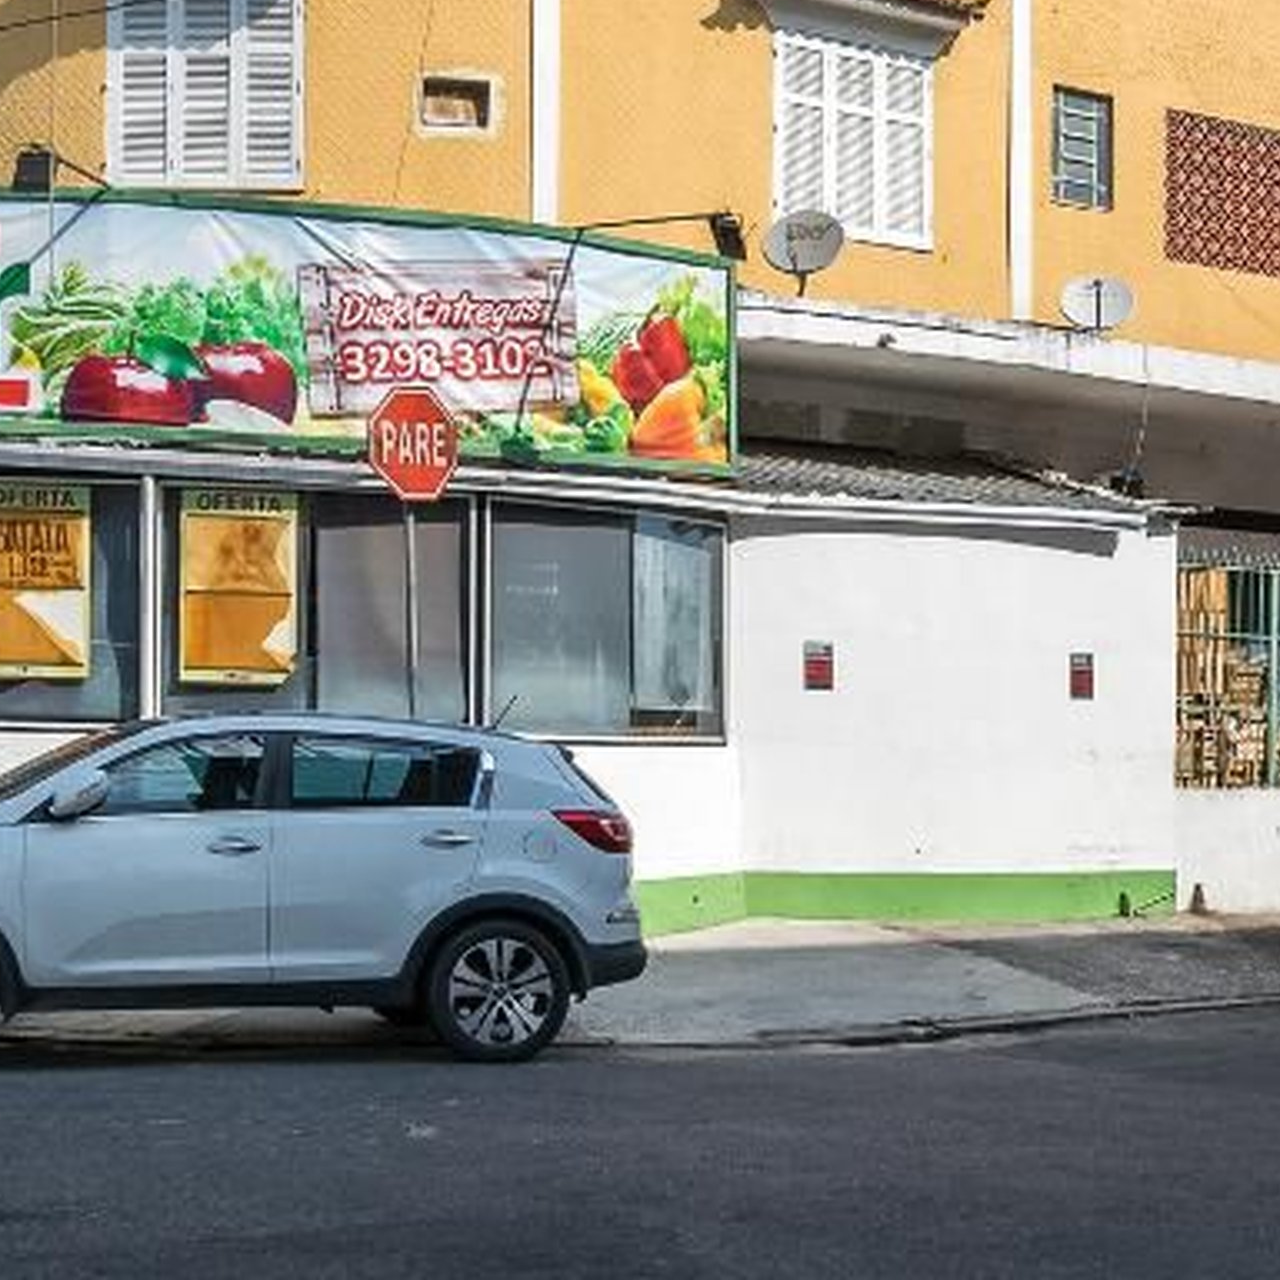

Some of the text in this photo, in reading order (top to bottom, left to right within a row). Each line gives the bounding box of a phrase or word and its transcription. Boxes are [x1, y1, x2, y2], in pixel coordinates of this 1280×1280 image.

[338, 290, 543, 334] Disk Entregas
[381, 419, 447, 467] PARE
[197, 492, 282, 512] OFERTA
